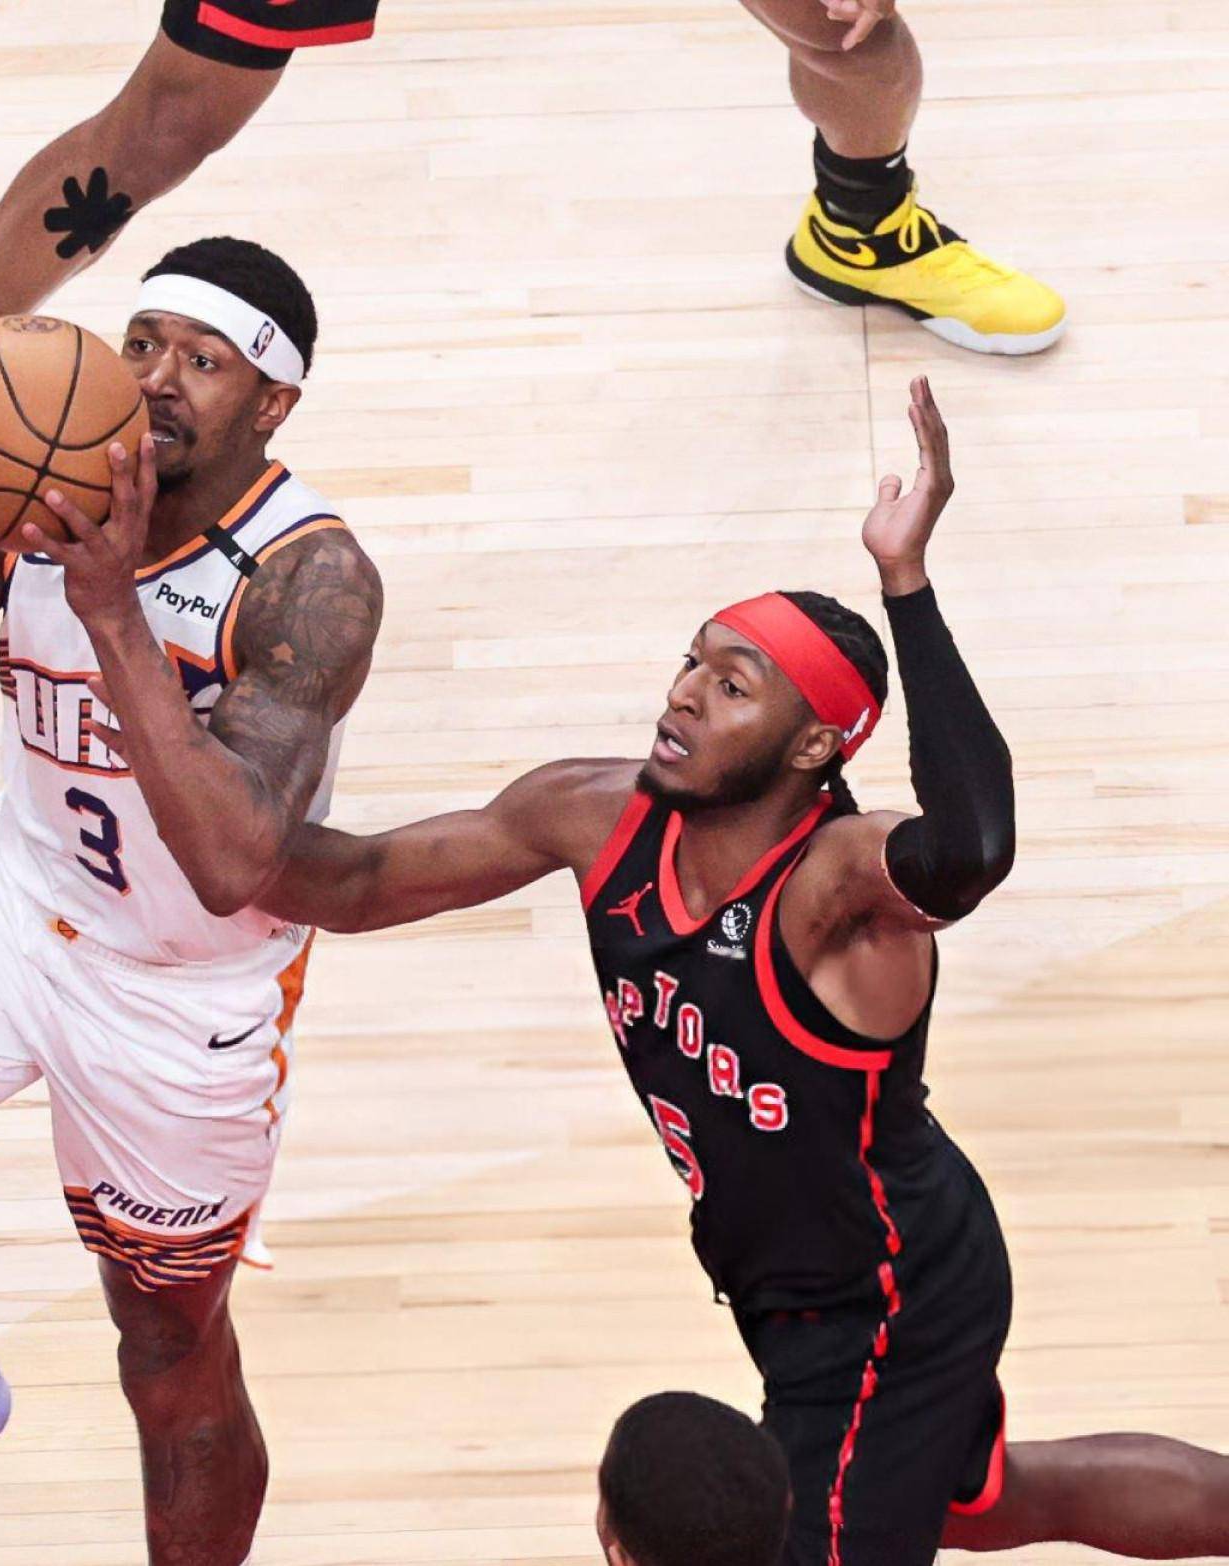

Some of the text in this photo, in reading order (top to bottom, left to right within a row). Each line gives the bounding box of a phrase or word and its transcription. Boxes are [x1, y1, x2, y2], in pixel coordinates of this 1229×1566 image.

[156, 582, 220, 619] PayPal
[10, 668, 129, 772] UN
[65, 786, 132, 896] 3
[605, 969, 788, 1131] PTORS
[648, 1093, 704, 1201] 5
[91, 1181, 228, 1227] PHOENIX
